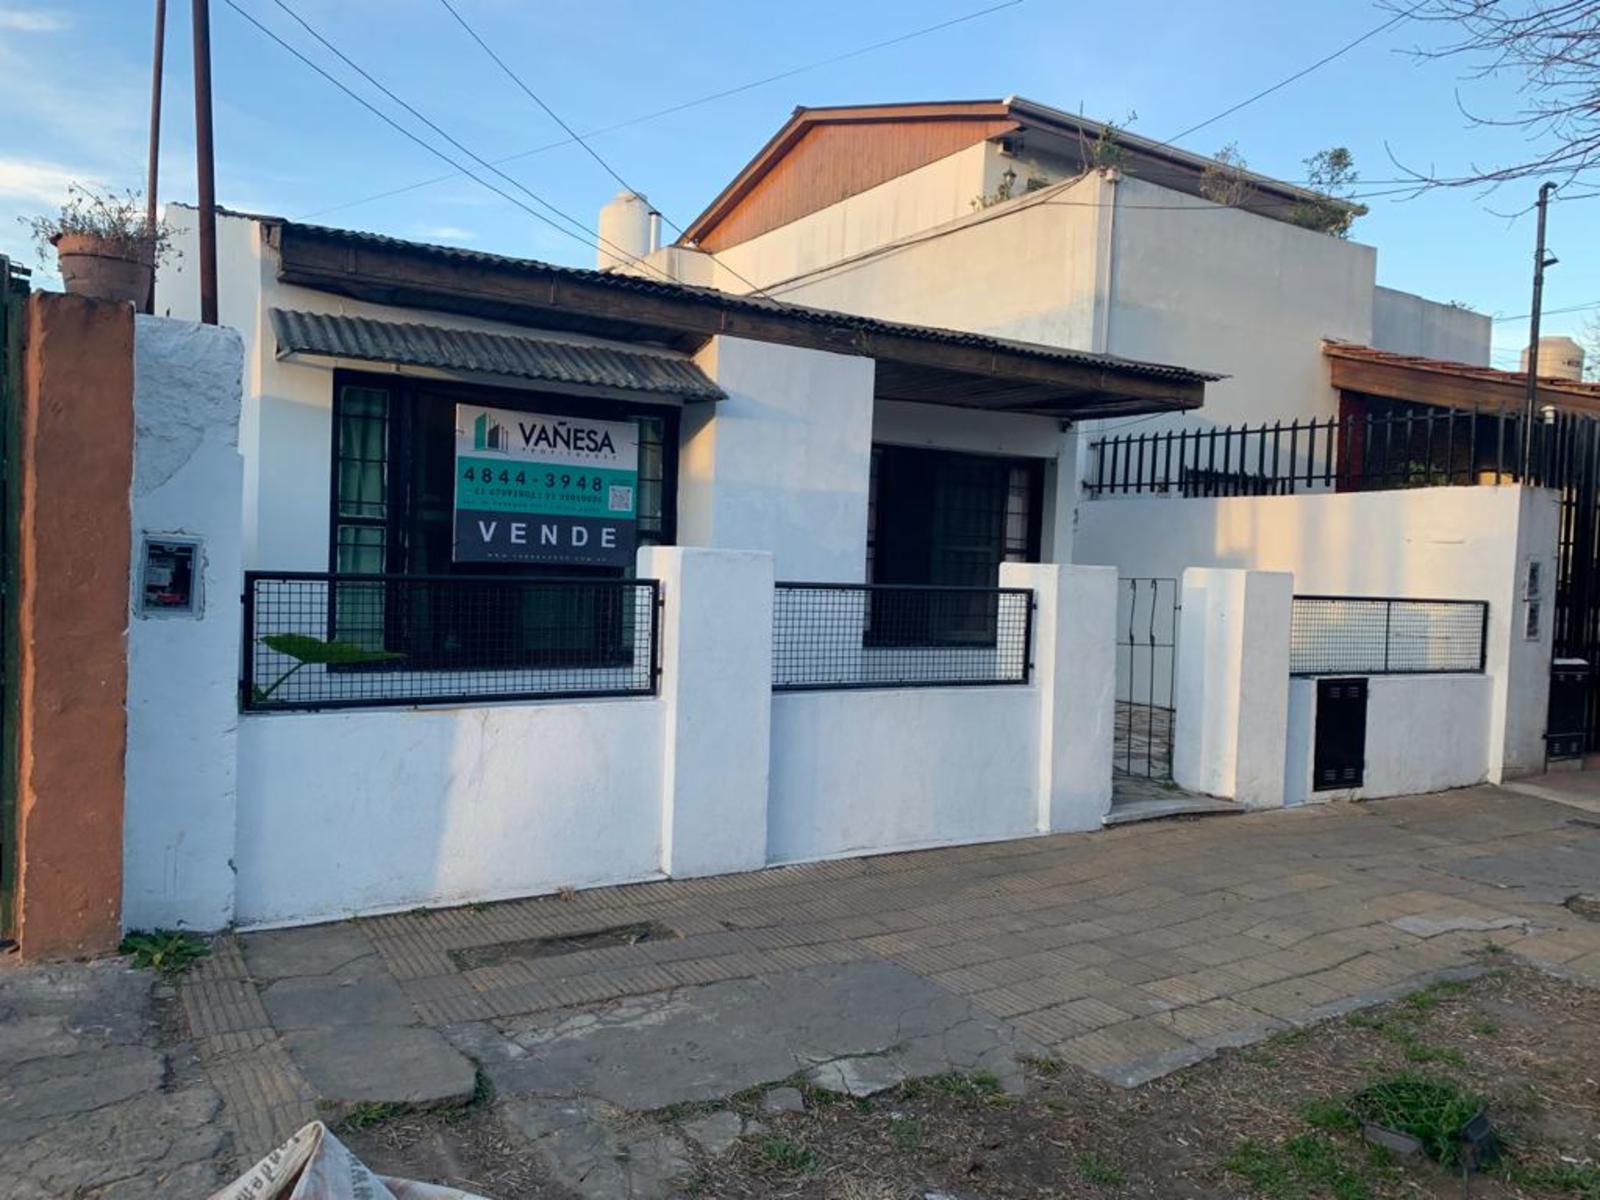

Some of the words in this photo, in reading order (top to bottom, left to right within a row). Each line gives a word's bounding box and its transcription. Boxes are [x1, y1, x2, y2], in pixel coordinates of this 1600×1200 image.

[518, 421, 616, 454] VAÑESA
[463, 466, 603, 492] 4844-3948
[478, 520, 617, 548] VENDE
